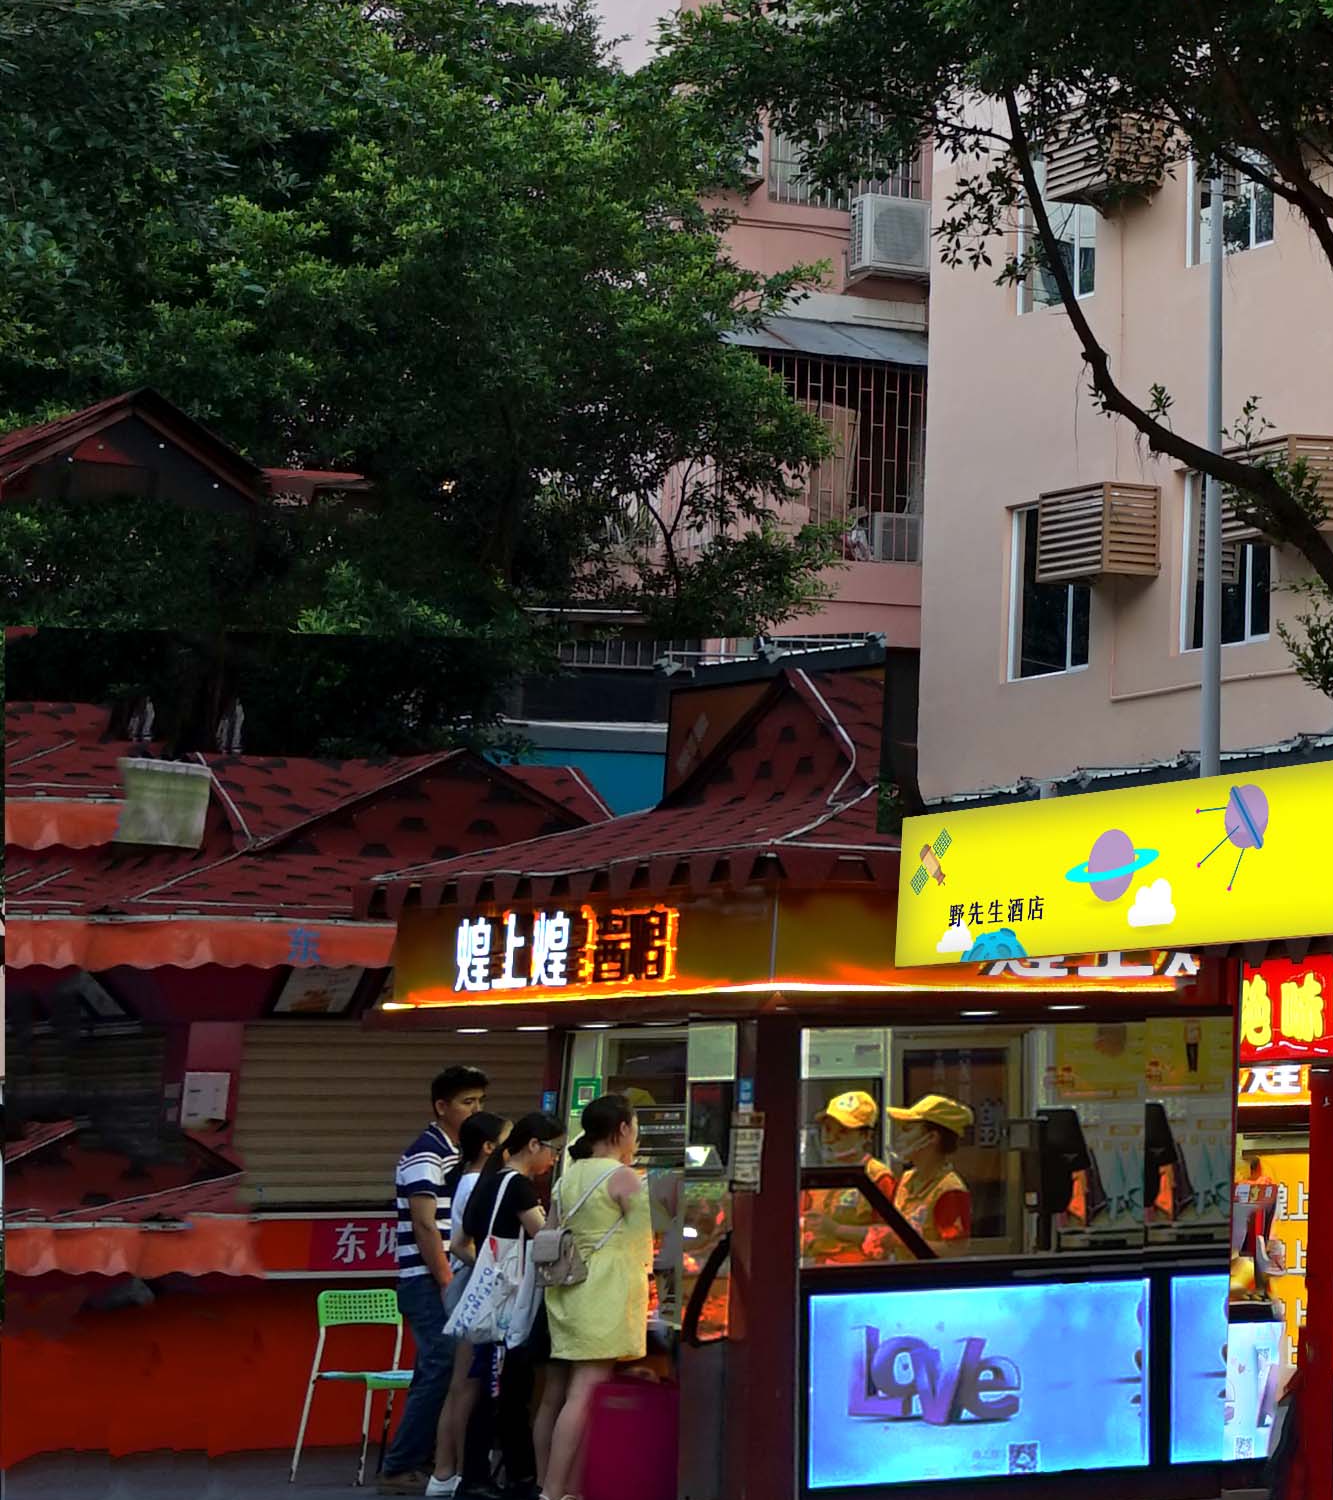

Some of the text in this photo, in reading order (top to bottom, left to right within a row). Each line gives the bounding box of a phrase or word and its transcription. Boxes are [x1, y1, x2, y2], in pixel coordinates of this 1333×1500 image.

[948, 896, 1045, 927] 野先生酒店
[455, 910, 570, 992] 煌上煌
